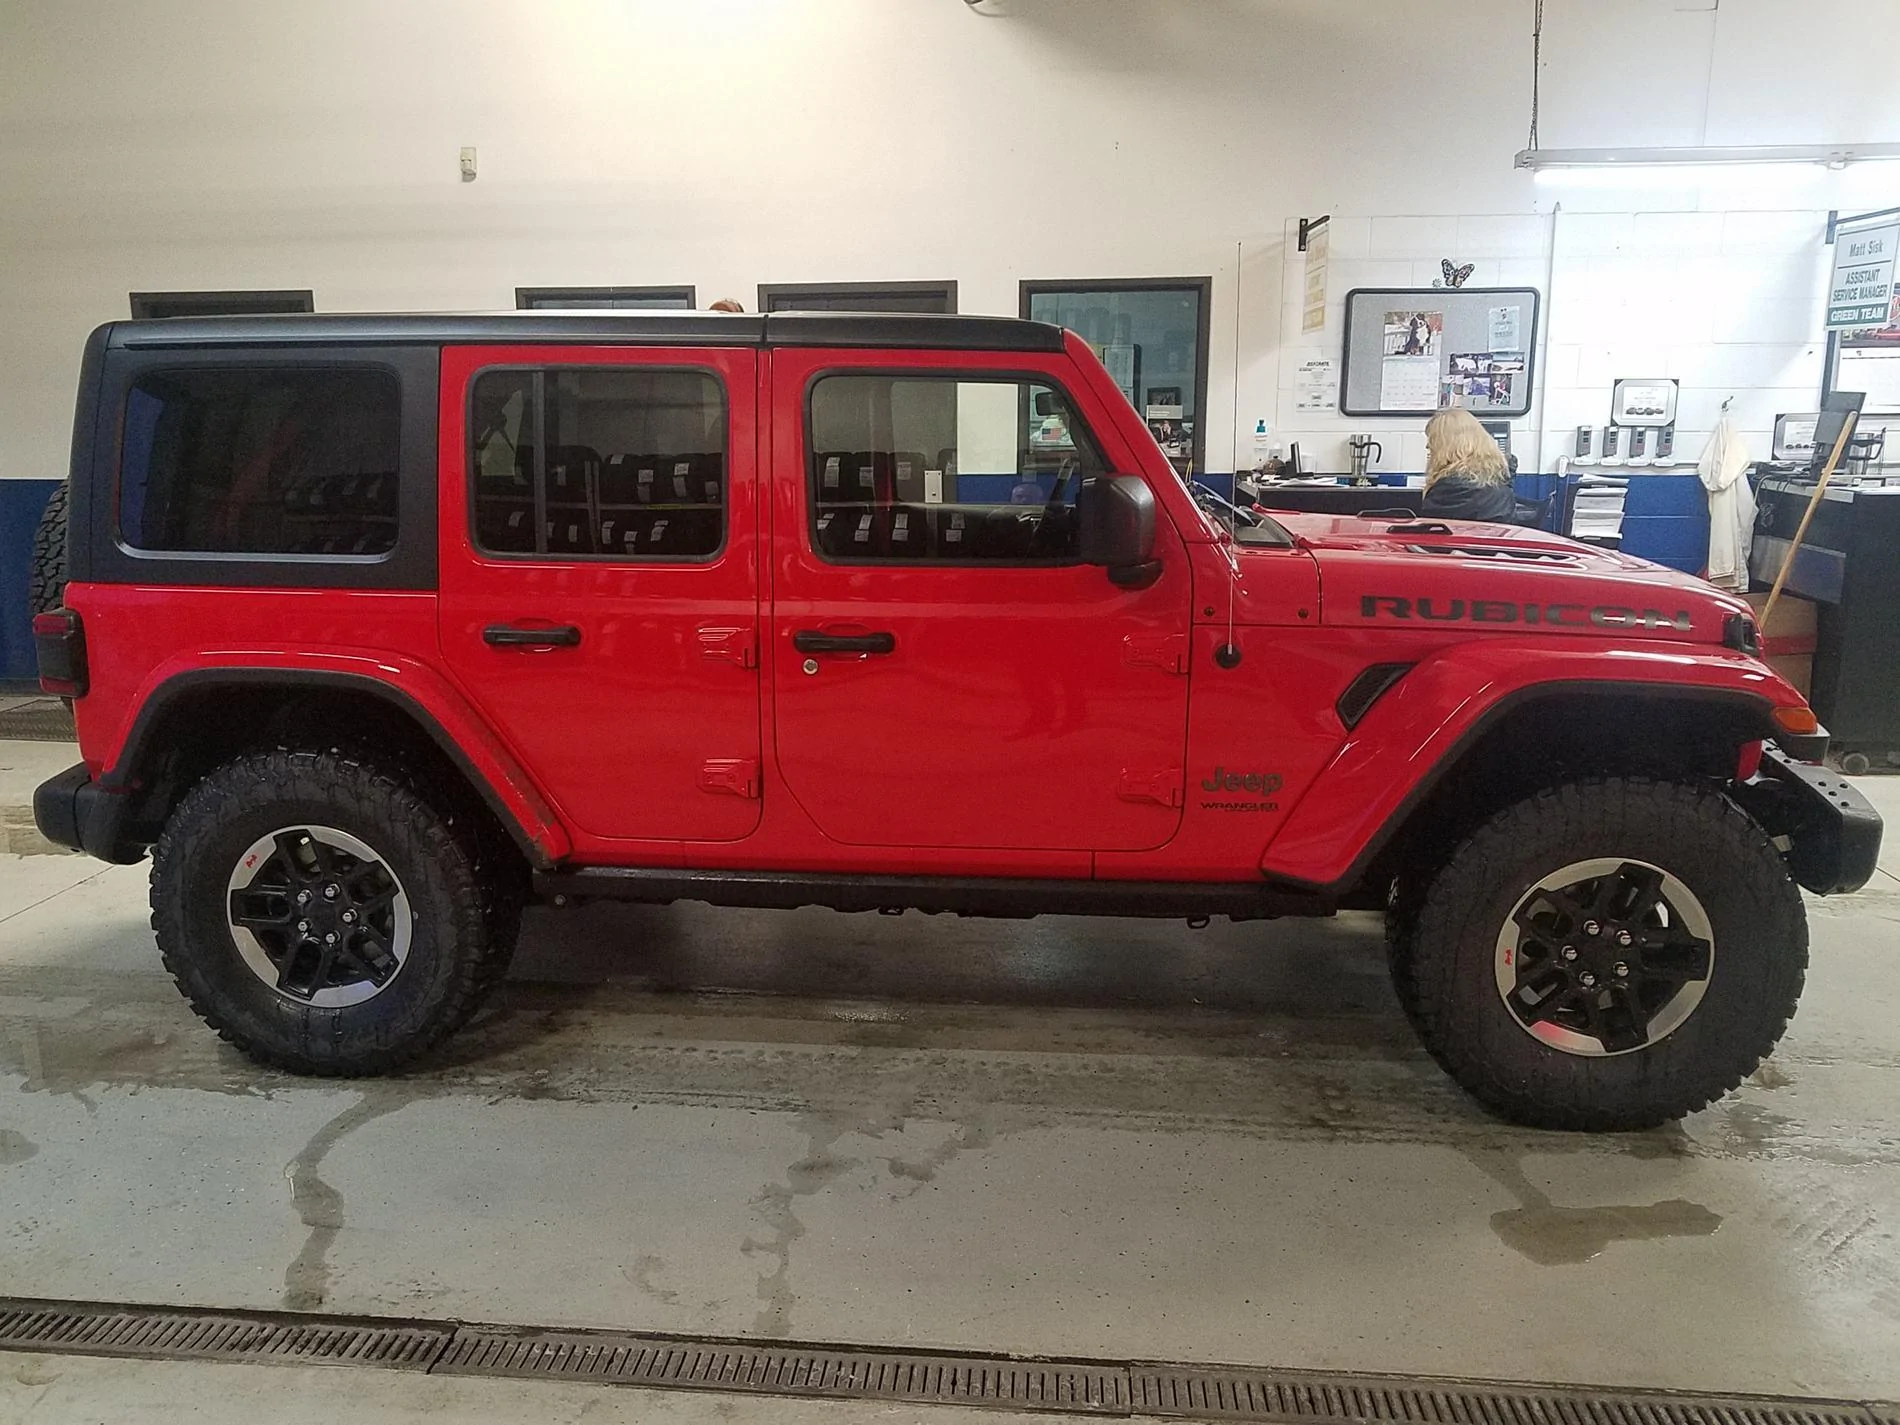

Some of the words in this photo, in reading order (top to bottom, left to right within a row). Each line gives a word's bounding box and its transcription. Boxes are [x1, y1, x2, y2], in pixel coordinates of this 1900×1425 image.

[1849, 243, 1866, 257] Matt
[1867, 240, 1883, 255] Sisk
[1845, 268, 1881, 285] ASSISTANT
[1832, 287, 1859, 302] SERVICE
[1859, 284, 1888, 299] MANAGER
[1831, 308, 1859, 322] GREEN
[1860, 306, 1885, 320] TEAM
[1361, 595, 1692, 631] RUBICON
[1201, 766, 1283, 796] Jeep
[1200, 802, 1279, 812] WRANGLER
